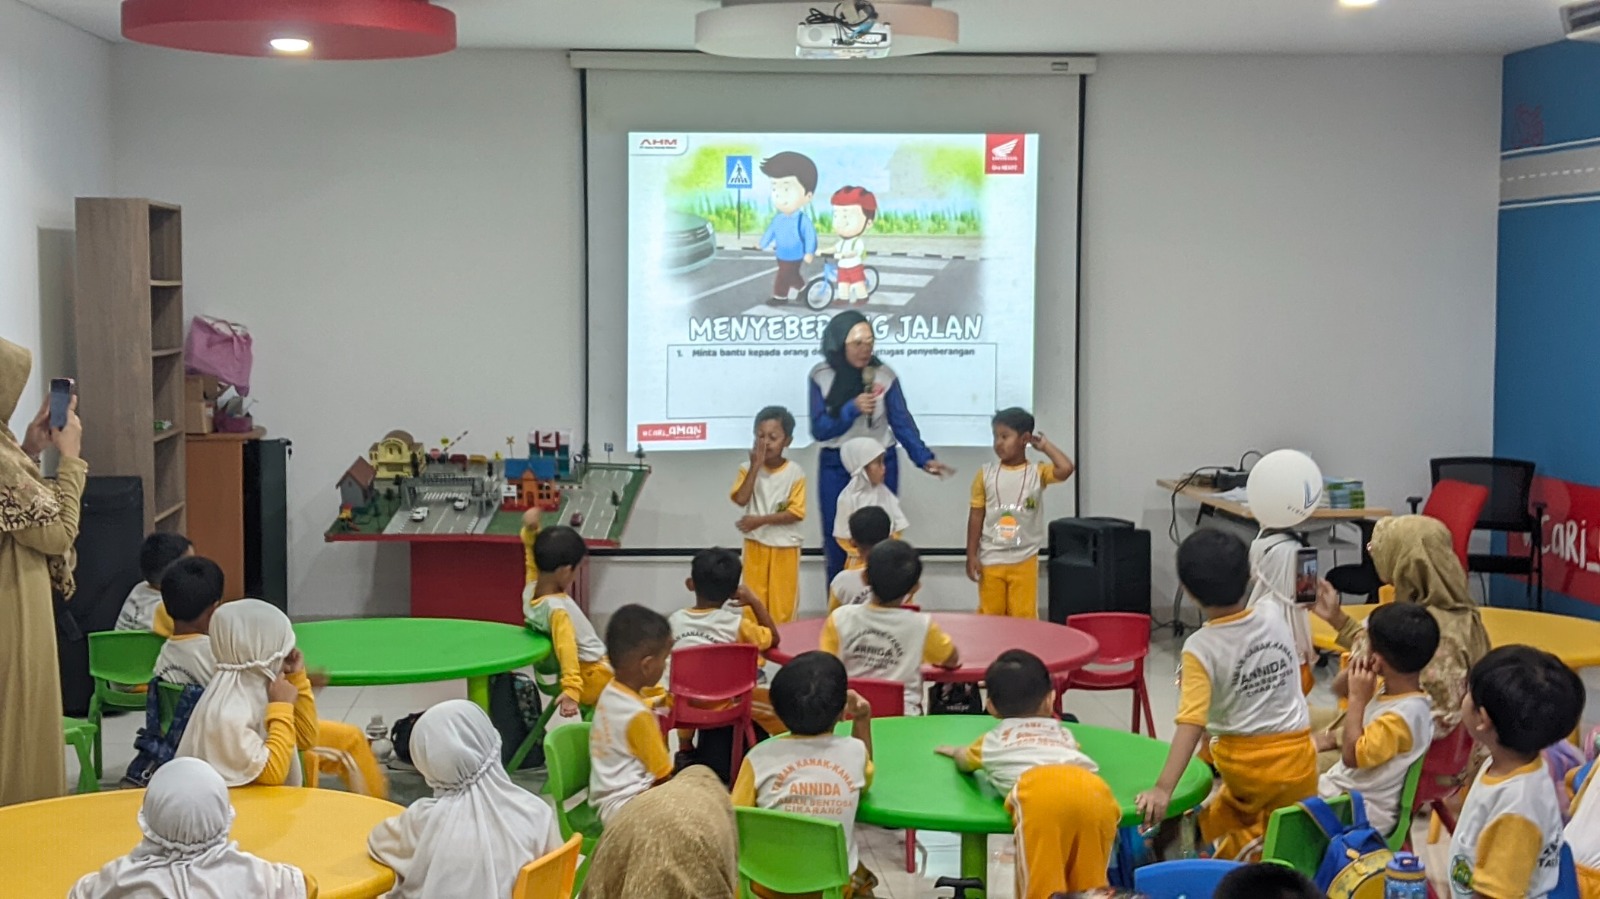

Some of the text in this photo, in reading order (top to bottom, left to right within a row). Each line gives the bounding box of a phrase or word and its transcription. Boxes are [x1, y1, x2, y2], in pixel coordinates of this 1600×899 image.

[689, 314, 983, 343] MENYEBERG JALAN
[692, 349, 718, 358] Minta
[720, 349, 746, 358] bantu
[748, 349, 781, 359] kepada
[783, 349, 809, 358] orang
[875, 348, 905, 358] etugas
[907, 348, 976, 358] penyeberangan
[1241, 658, 1287, 686] ANNIDA
[790, 783, 841, 797] ANNIDA
[784, 804, 843, 815] CIKARANG
